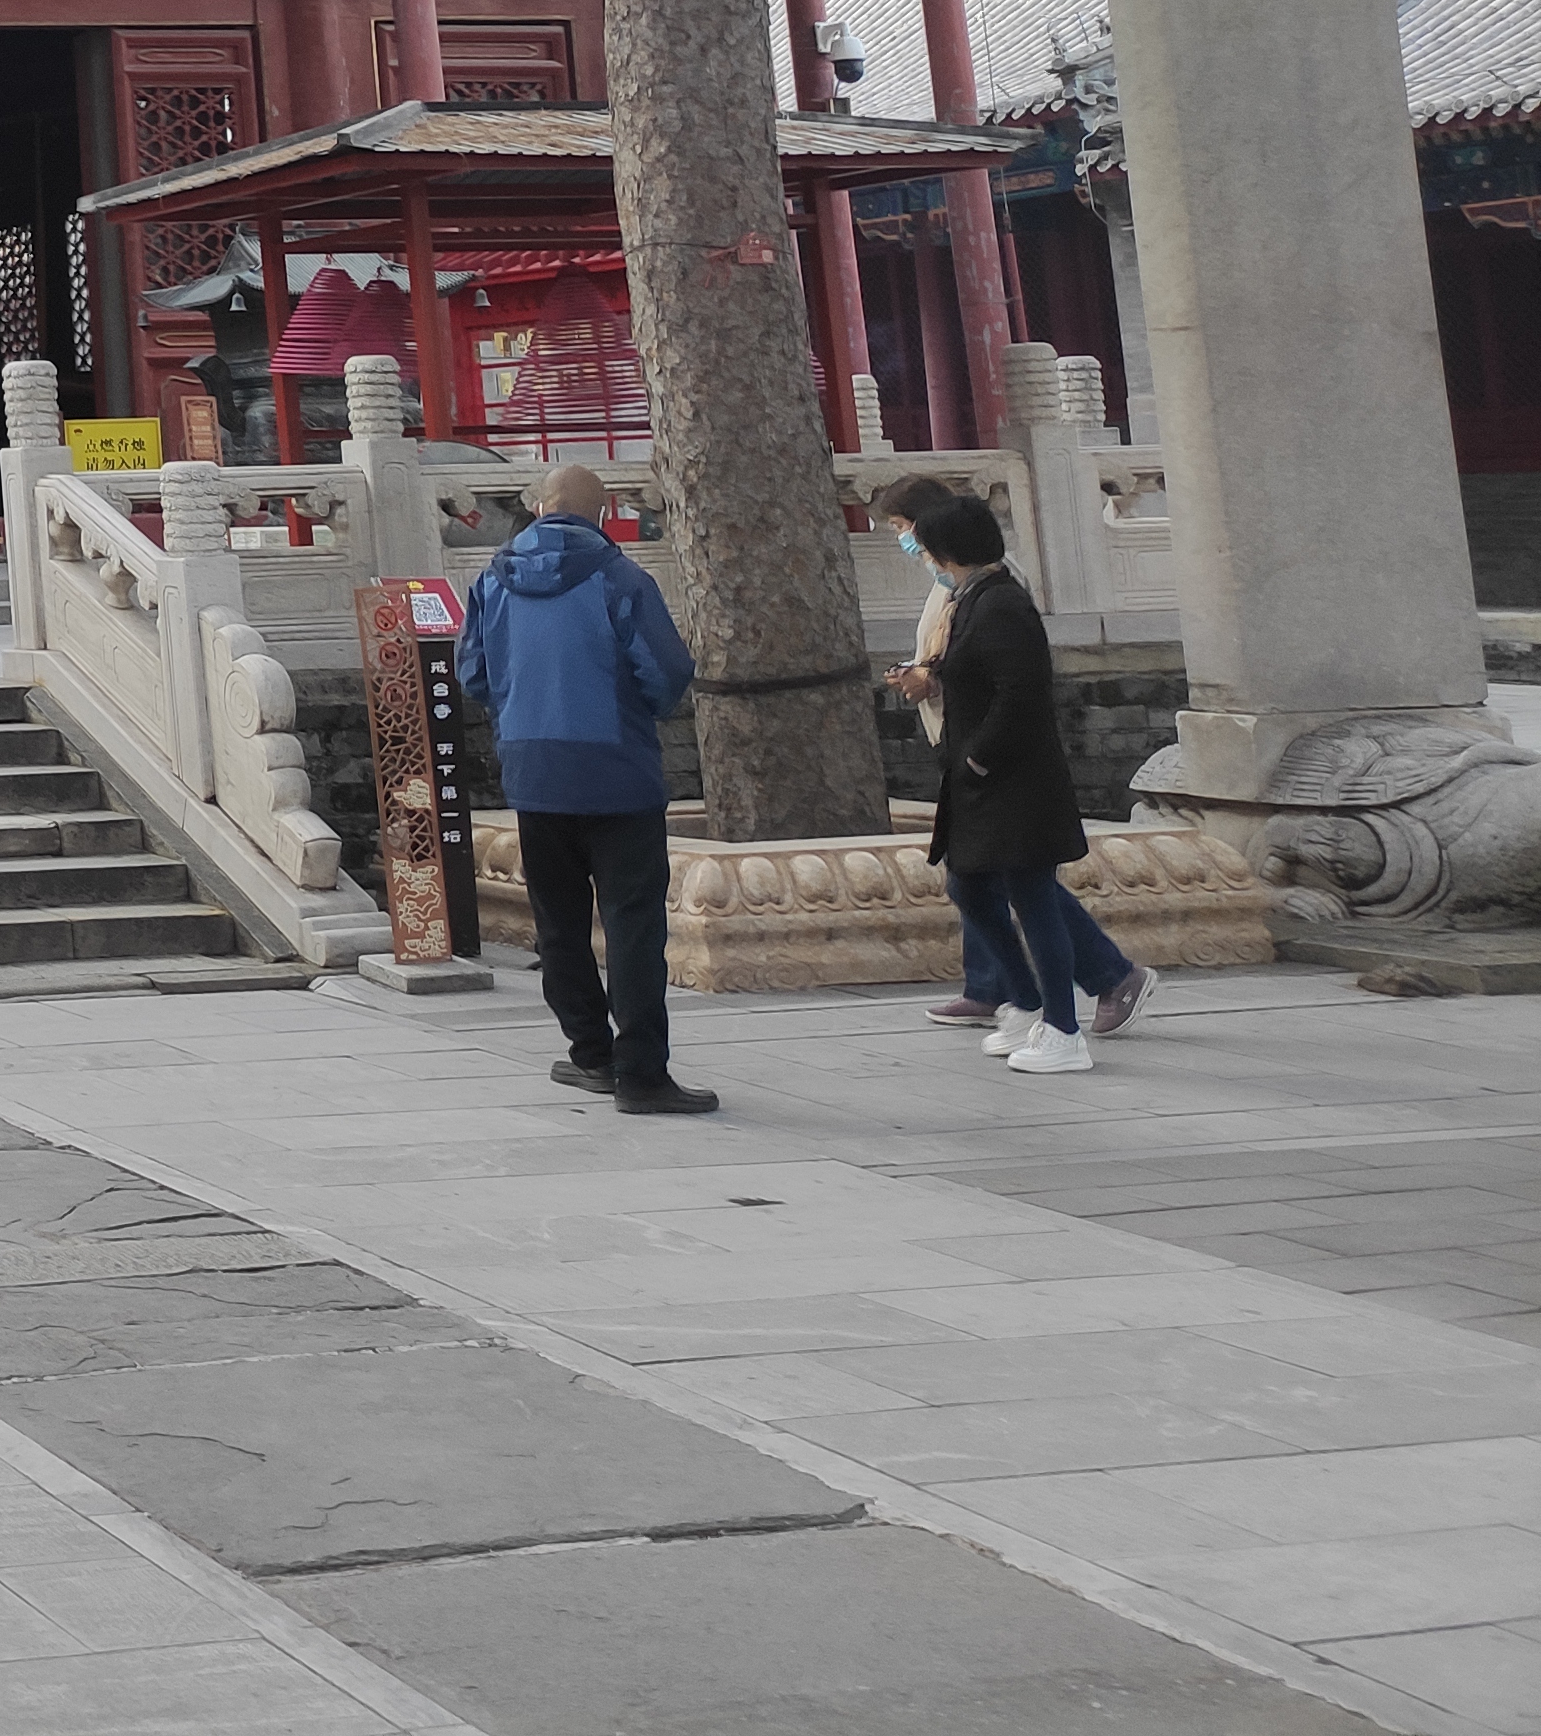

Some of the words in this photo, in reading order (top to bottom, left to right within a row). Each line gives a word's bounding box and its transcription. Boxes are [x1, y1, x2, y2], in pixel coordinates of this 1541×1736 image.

[84, 438, 147, 453] 点燃香烛
[86, 455, 147, 470] 请勿入内
[430, 660, 452, 720] 戒台寺
[436, 742, 463, 844] 天下第一坛
